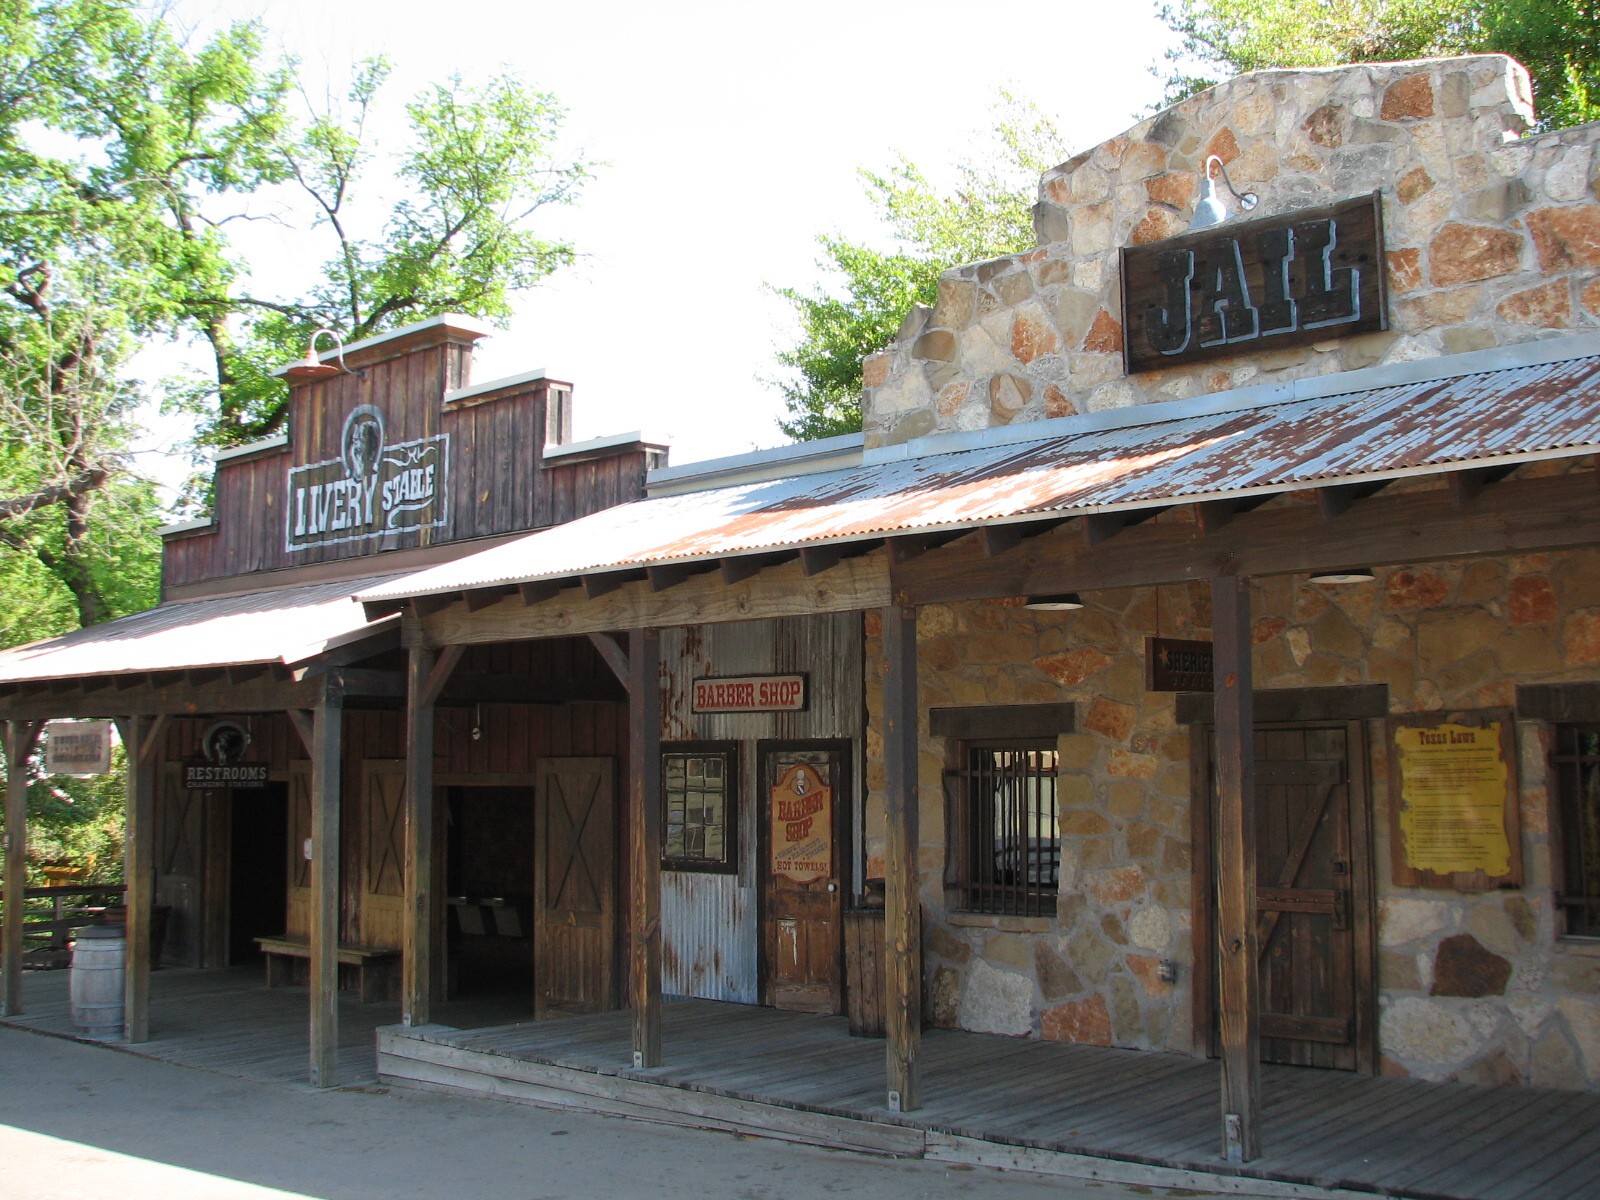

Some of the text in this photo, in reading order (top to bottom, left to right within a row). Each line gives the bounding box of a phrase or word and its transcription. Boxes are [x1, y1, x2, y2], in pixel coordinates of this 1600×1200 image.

[1146, 218, 1361, 356] JAIL
[295, 464, 435, 537] LIVERY STABLE
[1167, 651, 1214, 673] SHERIF
[696, 681, 800, 708] BARBER SHOP
[1418, 730, 1476, 745] Texas Laws
[187, 766, 267, 780] RESTROOMS
[778, 790, 823, 821] BARBER
[786, 816, 813, 842] SHOP
[777, 861, 827, 872] HOT TOWELS!
